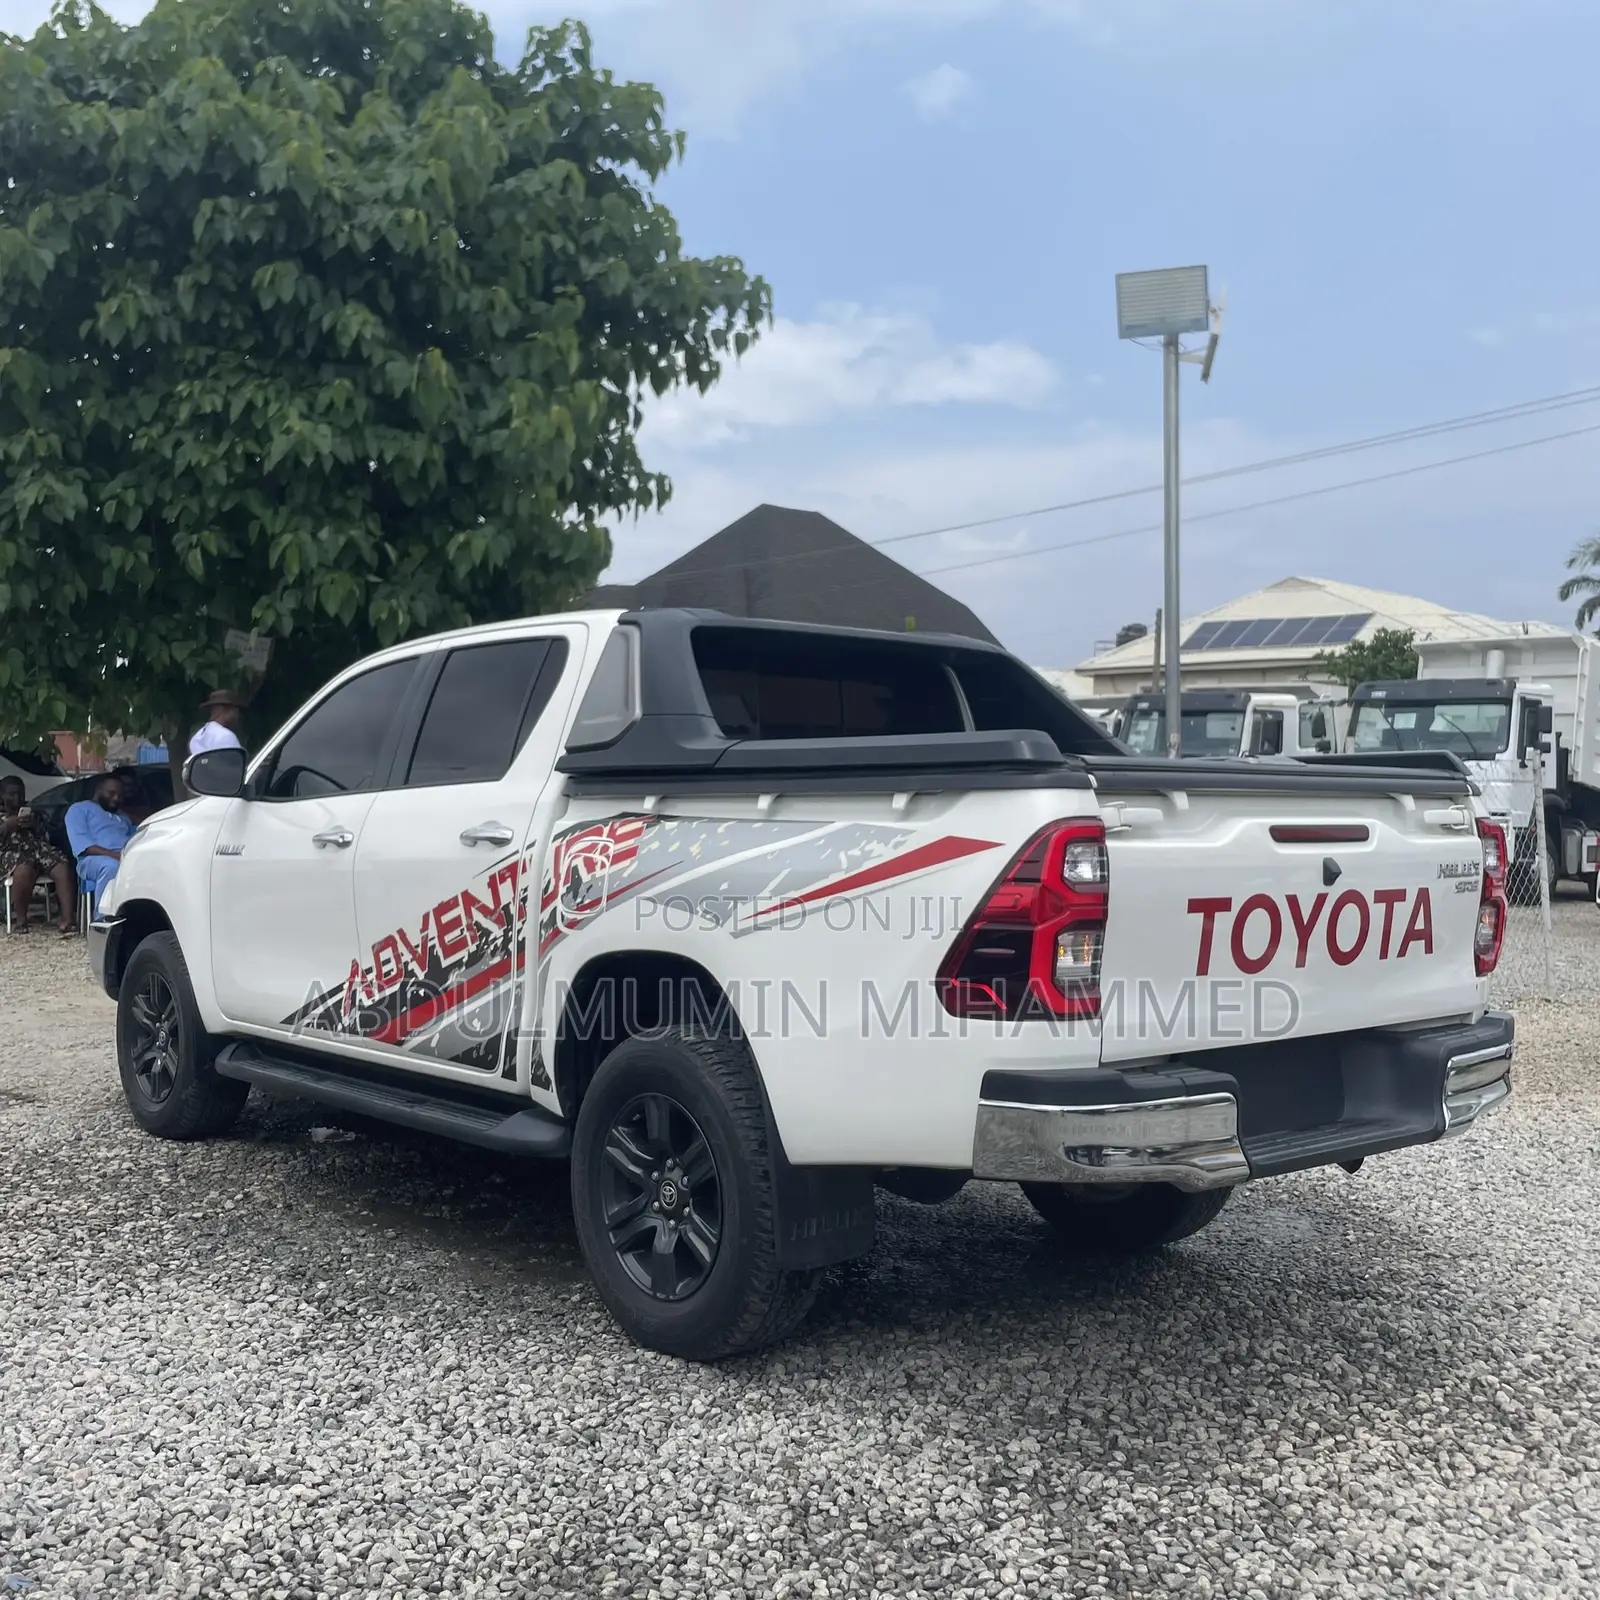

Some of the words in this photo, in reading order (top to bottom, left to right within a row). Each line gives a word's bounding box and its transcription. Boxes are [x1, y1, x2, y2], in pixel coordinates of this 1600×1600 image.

[1436, 860, 1481, 879] HILUX
[342, 813, 657, 1017] ADVENTURE
[1186, 887, 1434, 977] TOYOTA
